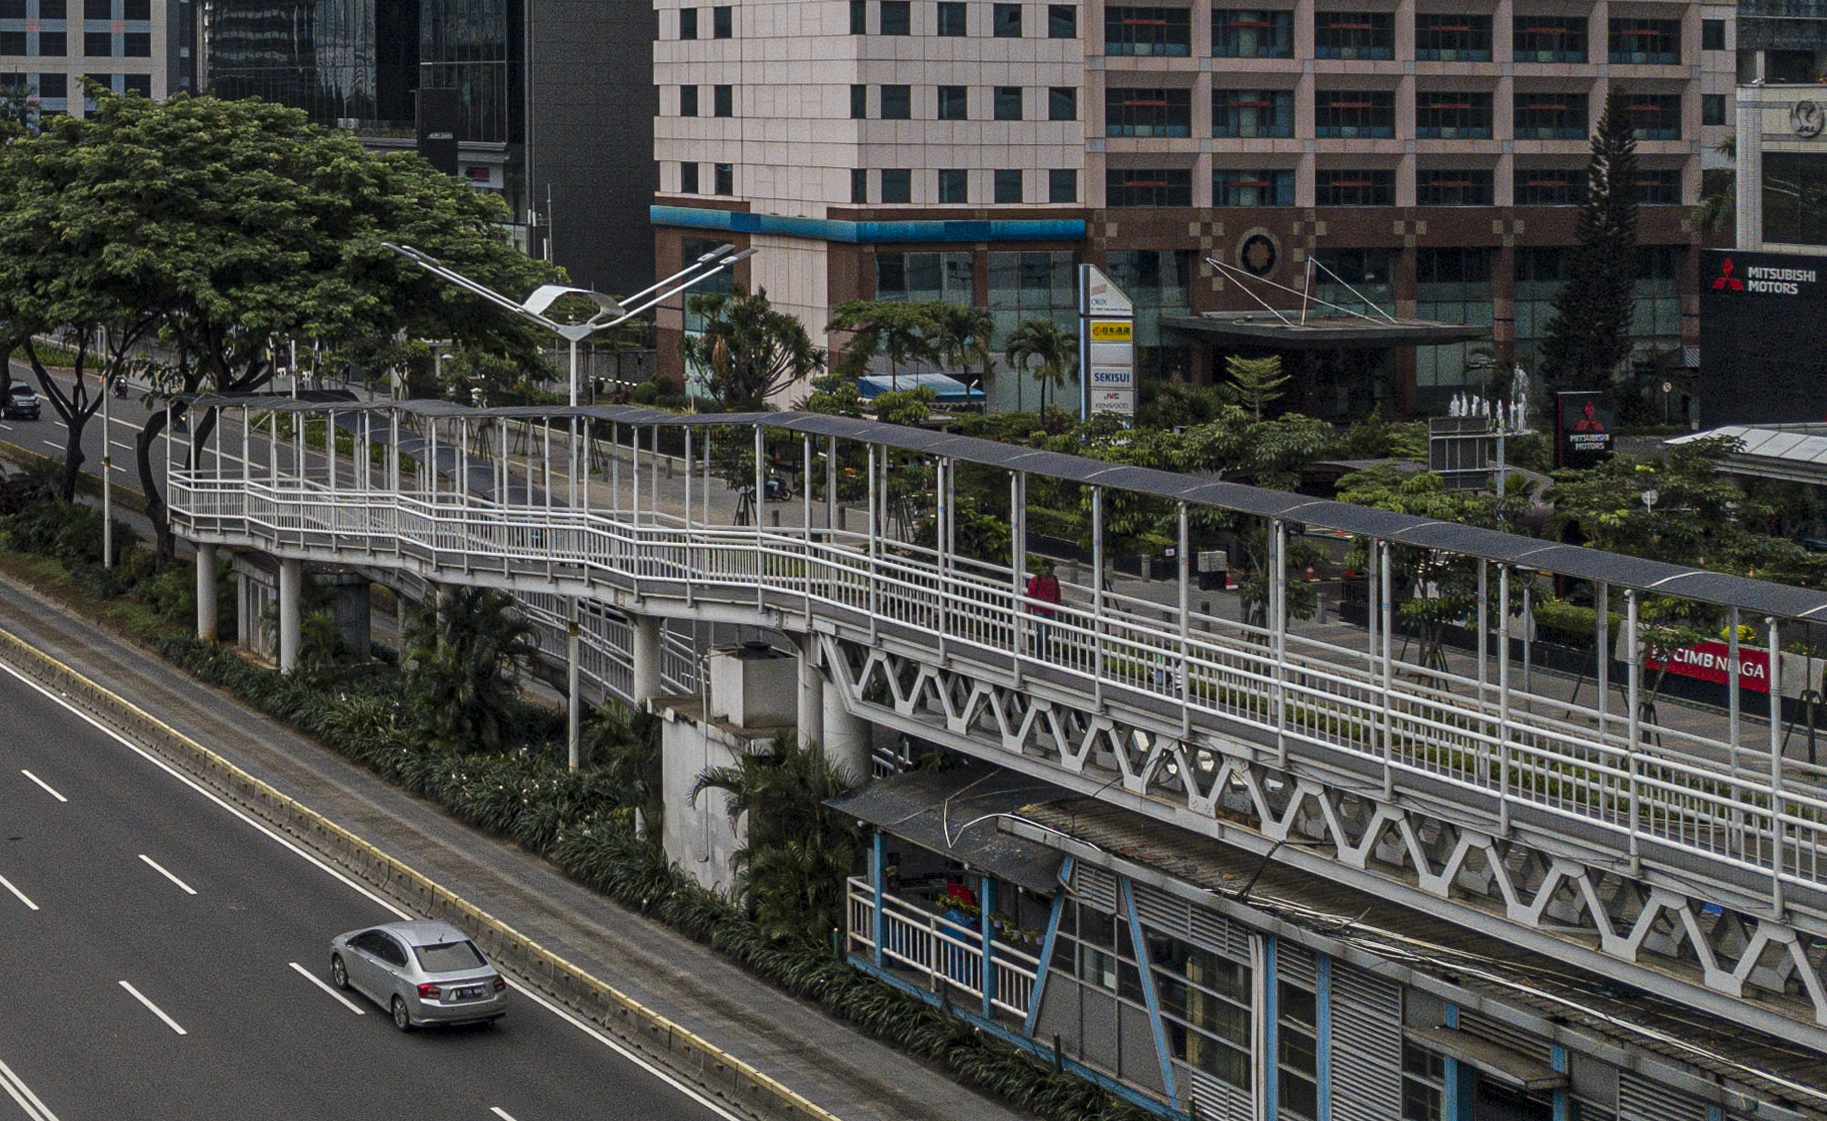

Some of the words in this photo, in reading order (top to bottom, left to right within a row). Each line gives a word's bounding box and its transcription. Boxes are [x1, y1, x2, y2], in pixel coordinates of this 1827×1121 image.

[1748, 267, 1816, 282] MITSUBISHI
[1748, 280, 1799, 295] MOTORS
[1094, 372, 1130, 383] SEKISUI
[1673, 648, 1714, 668] CIMB
